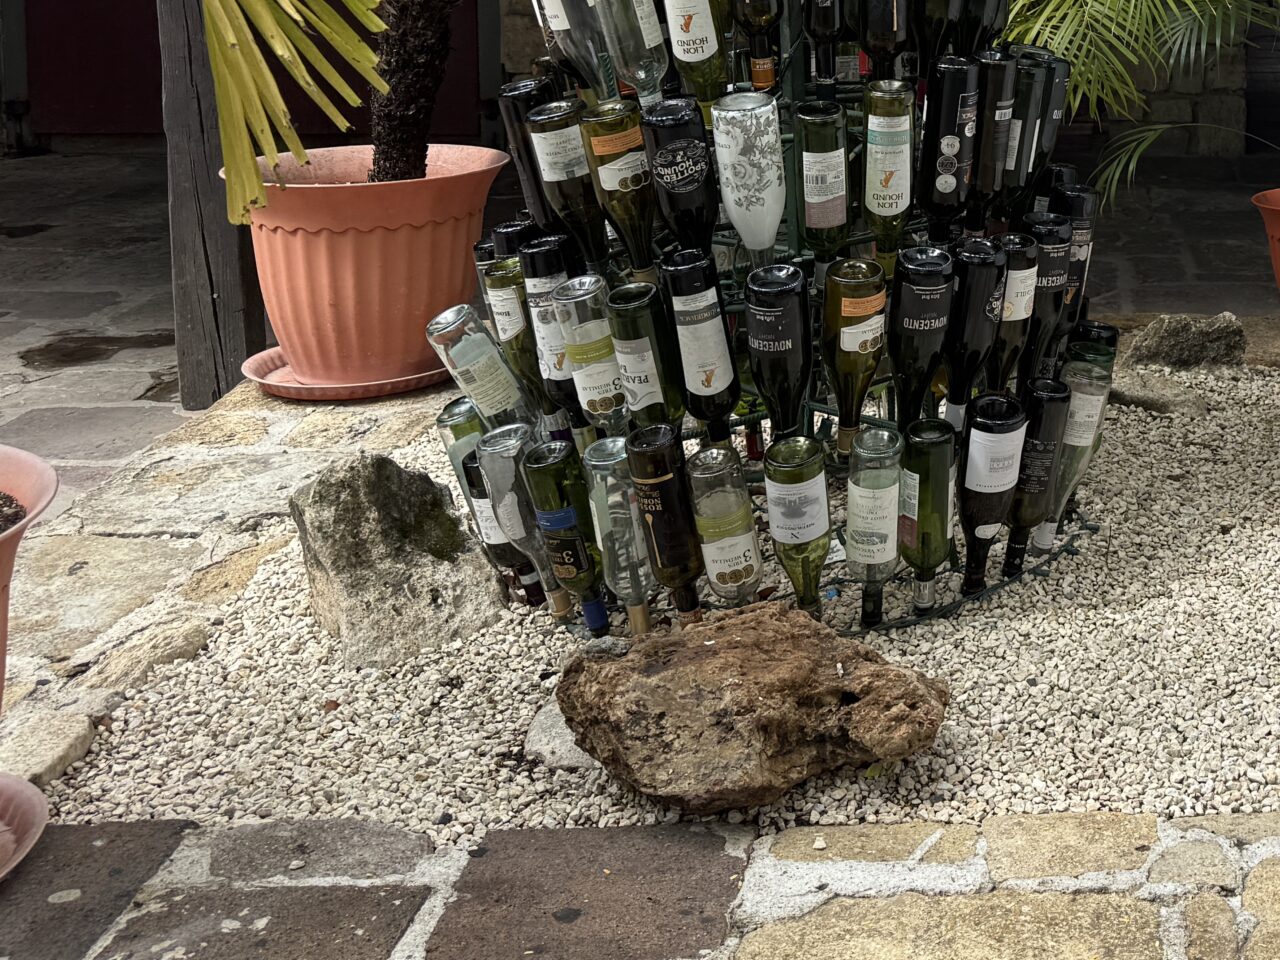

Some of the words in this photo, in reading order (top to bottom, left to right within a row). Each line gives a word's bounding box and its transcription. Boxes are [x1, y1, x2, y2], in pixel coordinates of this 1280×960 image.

[676, 36, 709, 48] HOUND
[682, 45, 705, 55] LION
[657, 158, 693, 174] HOUND
[662, 161, 706, 183] SPOTTED
[872, 192, 904, 201] HOUND
[877, 201, 899, 209] LION
[611, 377, 622, 391] 3
[562, 550, 574, 564] 3
[742, 548, 752, 563] 3
